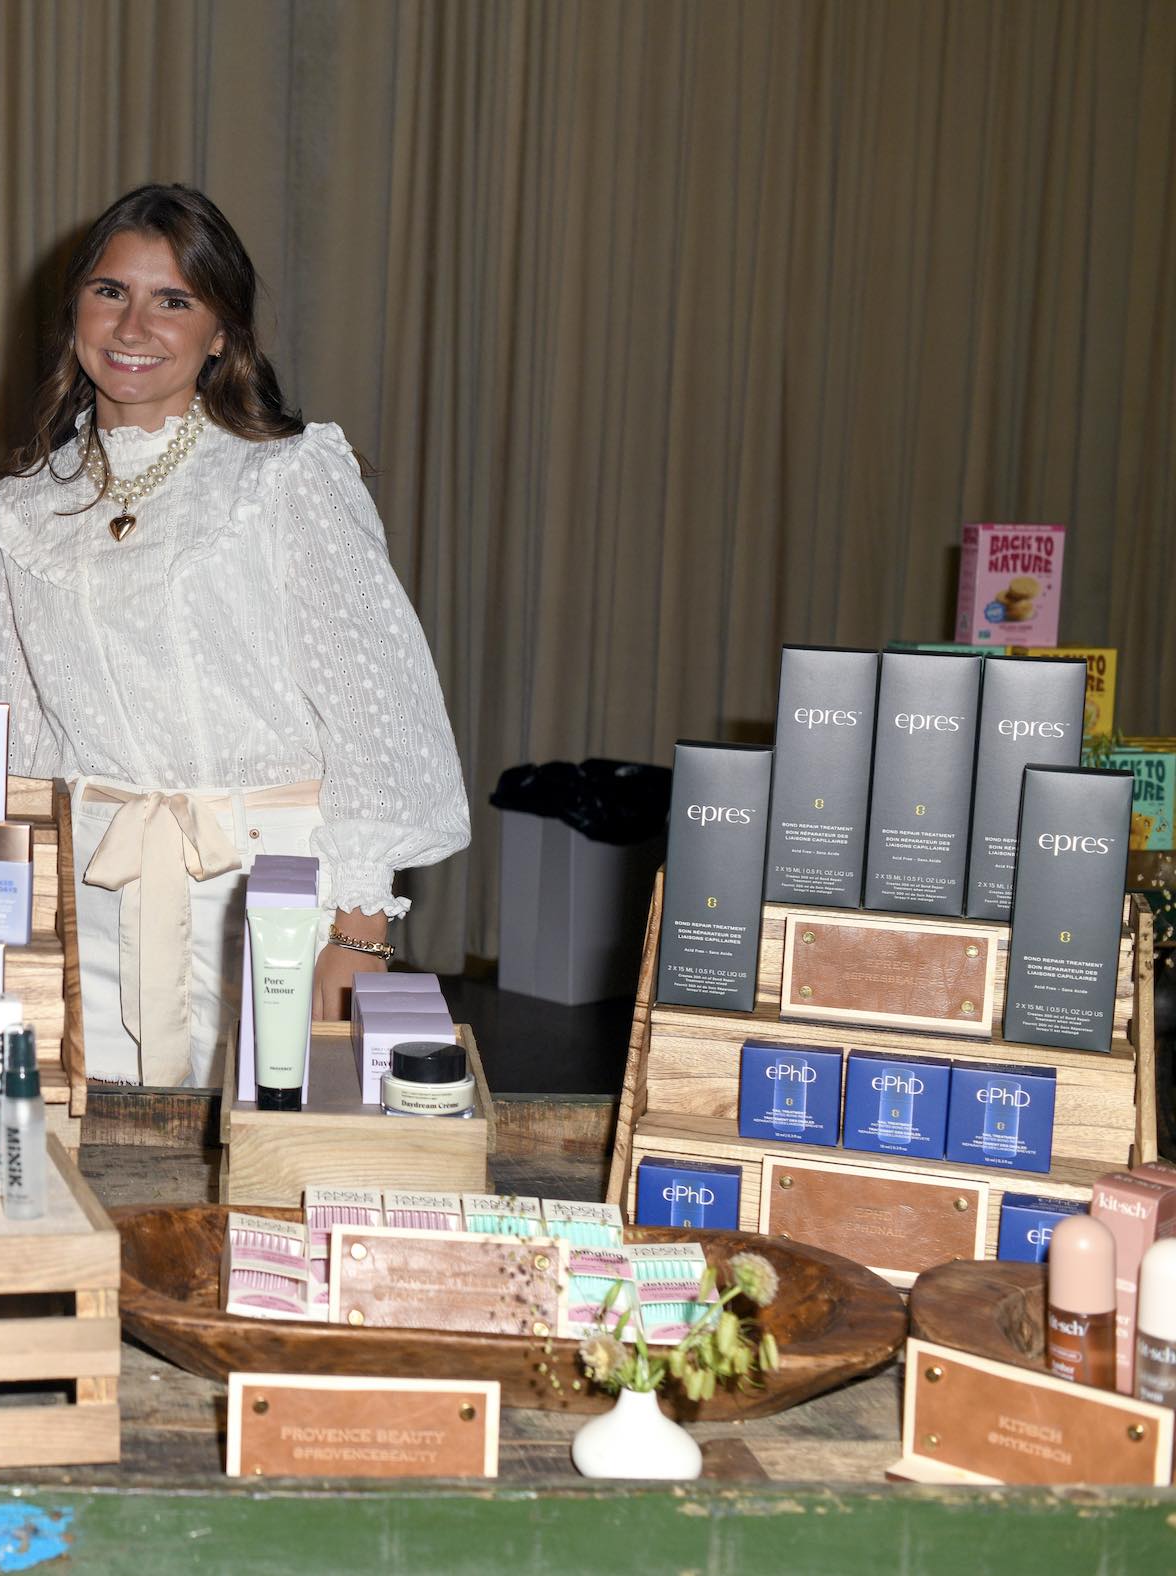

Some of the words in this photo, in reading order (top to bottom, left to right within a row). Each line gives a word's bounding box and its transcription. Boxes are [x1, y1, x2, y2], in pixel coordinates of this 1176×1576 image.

[990, 534, 1032, 555] BACK
[1035, 536, 1054, 556] TO
[989, 554, 1053, 573] NATURE
[1089, 654, 1106, 676] TO
[794, 706, 856, 729] epres
[894, 711, 959, 734] epres
[998, 718, 1064, 742] epres
[1145, 760, 1165, 782] TO
[1133, 780, 1165, 801] URE
[687, 804, 751, 826] epres
[800, 830, 836, 838] RÉPARATEUR
[901, 836, 938, 845] RÉPARATEUR
[1038, 832, 1109, 856] epres
[693, 929, 729, 938] RÉPARATEUR
[866, 960, 911, 970] EPRES
[1044, 965, 1084, 974] RÉPARATEUR
[1057, 973, 1097, 982] CAPILLAIRES
[766, 1064, 816, 1083] ePhD
[872, 1076, 924, 1095] ePhD
[401, 1100, 436, 1109] Daydream
[976, 1088, 1030, 1107] ePhD
[662, 1185, 714, 1205] ePhD
[1026, 1228, 1052, 1245] eP
[280, 1426, 372, 1443] PROVENCE
[376, 1430, 445, 1445] BEAUTY
[999, 1415, 1062, 1444] KITSCH
[293, 1447, 437, 1463] @PROVENCEBEAUTY
